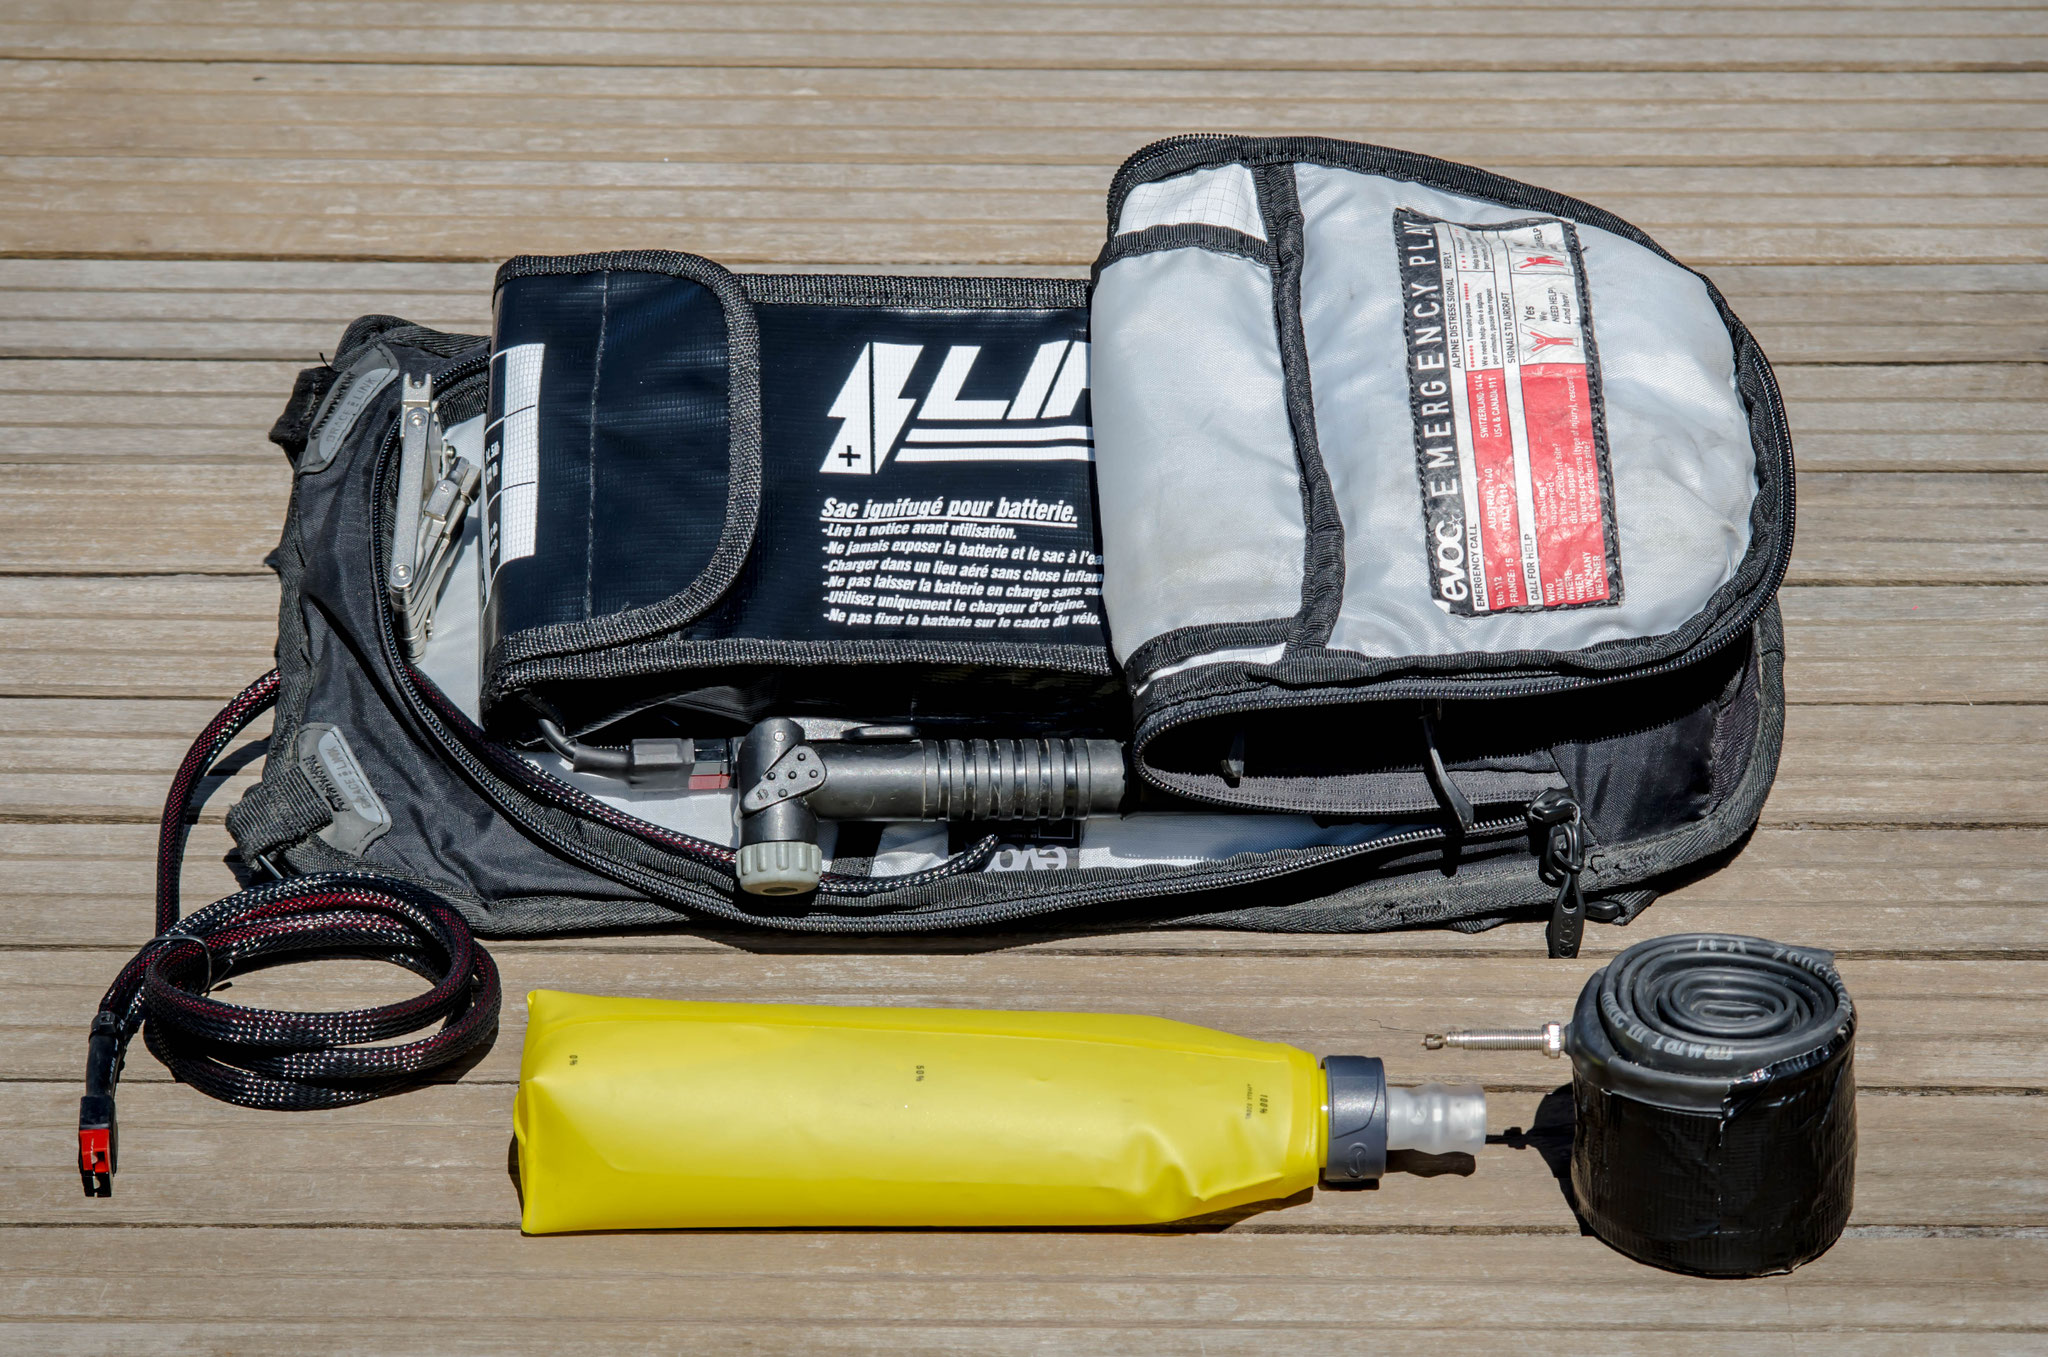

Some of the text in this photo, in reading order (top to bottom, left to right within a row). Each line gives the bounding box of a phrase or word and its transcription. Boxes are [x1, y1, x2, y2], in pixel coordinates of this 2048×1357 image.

[1442, 252, 1452, 269] REPLY
[1476, 292, 1484, 309] signals
[1486, 288, 1494, 304] repeat
[1465, 302, 1473, 318] pause
[1524, 306, 1536, 321] Yes
[1540, 312, 1548, 322] We
[1550, 306, 1560, 322] NEED
[1562, 308, 1572, 324] Land
[1446, 278, 1461, 368] ALPINE DISTRESS SIGNAL
[1466, 318, 1474, 338] minute
[1501, 292, 1516, 364] SIGNALS TO AIRCRAFT
[1480, 341, 1488, 354] need
[1481, 356, 1488, 366] We
[1492, 354, 1500, 365] per
[353, 378, 378, 400] LINK
[1411, 282, 1458, 497] EMERGENCY
[1488, 377, 1497, 388] 911
[1474, 374, 1489, 438] SWITZERLAND: 1414
[1490, 389, 1500, 415] CANADA:
[1494, 424, 1502, 438] USA
[1552, 443, 1562, 460] site?
[1582, 440, 1592, 459] site?
[1555, 460, 1566, 499] accident
[1576, 456, 1588, 489] persons
[1584, 460, 1595, 495] accident
[821, 496, 1078, 522] Sac ignifugé pour batterie.
[1486, 486, 1497, 530] AUSTRIA:
[1500, 501, 1510, 530] ITALY:
[1558, 500, 1567, 515] the
[1568, 510, 1578, 524] did
[1578, 491, 1589, 523] injured
[821, 522, 1017, 539] -Lire la notice avant utilisation.
[822, 539, 1104, 566] -Ne jamais exposer la batterie et le sac à l'ea
[1435, 518, 1469, 601] evoc
[822, 557, 1104, 583] -Charger dans un lieu aéré sans chose inflam
[1469, 523, 1485, 607] EMERGENCY CALL
[1524, 534, 1540, 600] CALL FOR HELP
[1582, 551, 1595, 598] HOW MANY
[1593, 555, 1604, 596] WEATHER
[822, 574, 1103, 600] -Ne pas laisser la batterie en charge sans su
[1494, 576, 1505, 606] EU: 112
[1505, 558, 1519, 603] FRANCE: 15
[1546, 582, 1556, 602] WHO
[1556, 578, 1566, 601] WHAT
[1574, 573, 1586, 600] WHEN
[822, 590, 1088, 616] -Utilisez uniquement le chargeur d'origine.
[823, 608, 1101, 629] -Ne pas fixer la batterie sur le cadre du vélo.
[984, 844, 1068, 872] evo
[569, 1054, 579, 1066] 0%
[915, 1065, 925, 1082] 50%
[1259, 1094, 1269, 1114] 100%
